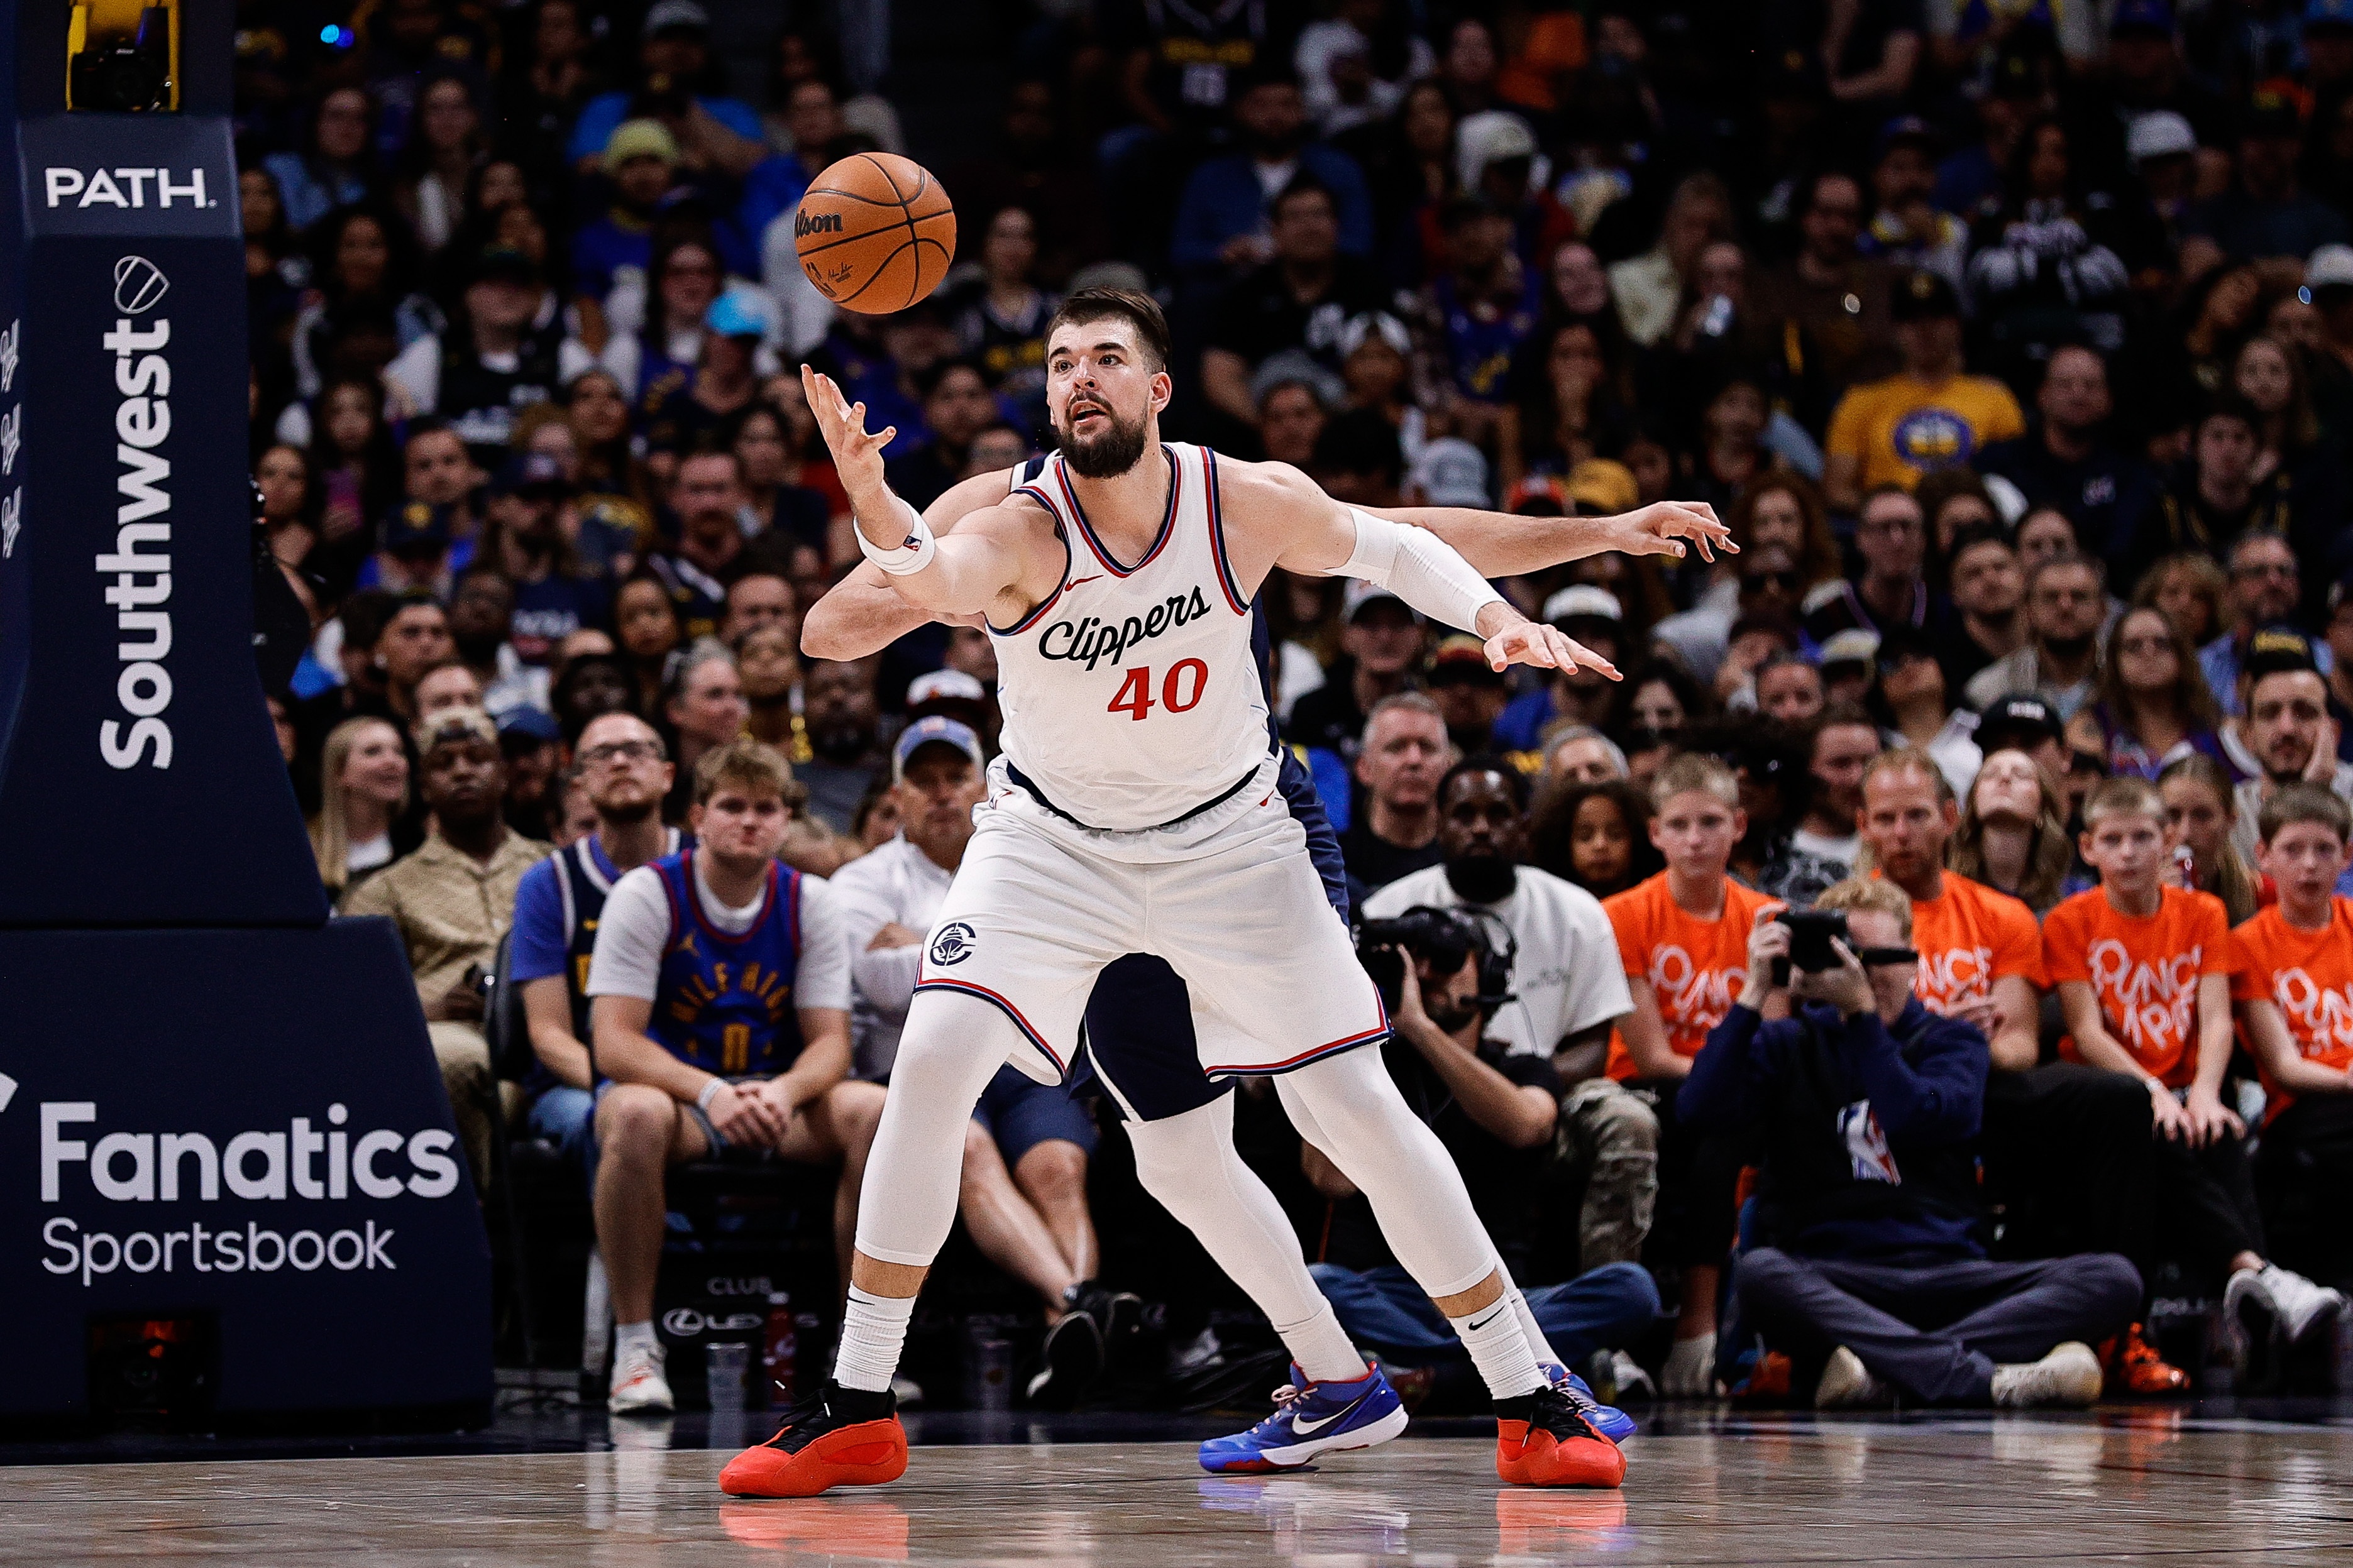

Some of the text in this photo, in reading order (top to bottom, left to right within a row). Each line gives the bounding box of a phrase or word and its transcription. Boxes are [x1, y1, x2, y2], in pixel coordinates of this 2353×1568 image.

[45, 167, 207, 208] PATH
[96, 319, 172, 769] Southwest
[1039, 584, 1212, 672] Clippers
[1107, 657, 1208, 721] 40
[40, 1102, 459, 1202] Fanatics
[41, 1217, 396, 1286] Sportsbook
